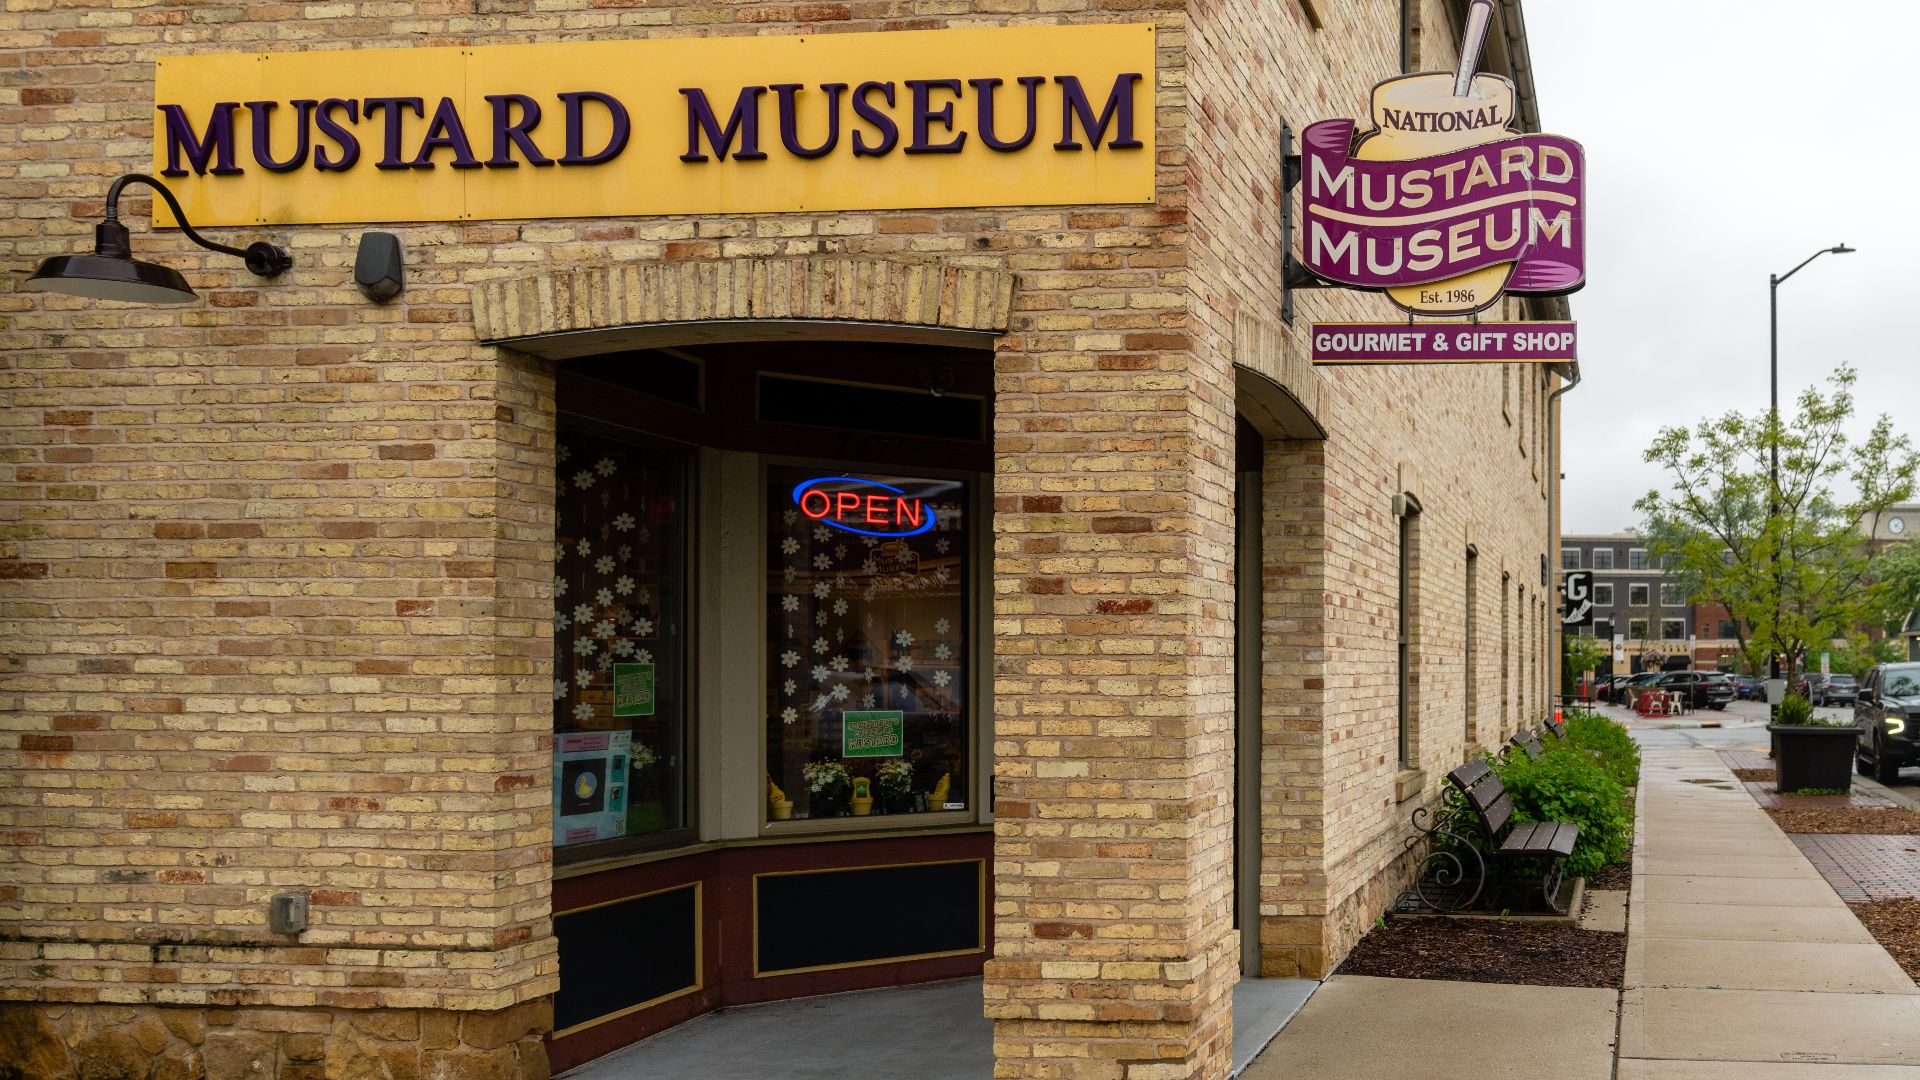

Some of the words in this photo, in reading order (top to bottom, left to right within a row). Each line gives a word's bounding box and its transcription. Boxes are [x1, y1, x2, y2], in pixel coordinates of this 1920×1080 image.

[157, 91, 631, 177] MUSTARD
[679, 73, 1143, 162] MUSEUM
[1382, 105, 1502, 133] NATIONAL
[1311, 145, 1574, 211] MUSTARD
[1311, 207, 1572, 276] MUSEUM
[1420, 290, 1443, 304] Est.
[1447, 289, 1475, 303] 1986
[1315, 333, 1426, 352] GOURMET
[1432, 333, 1449, 352] &
[1455, 332, 1507, 351] GIFT
[1512, 332, 1575, 351] SHOP
[800, 489, 920, 527] OPEN
[873, 553, 917, 566] MUSTD
[1567, 573, 1588, 601] G
